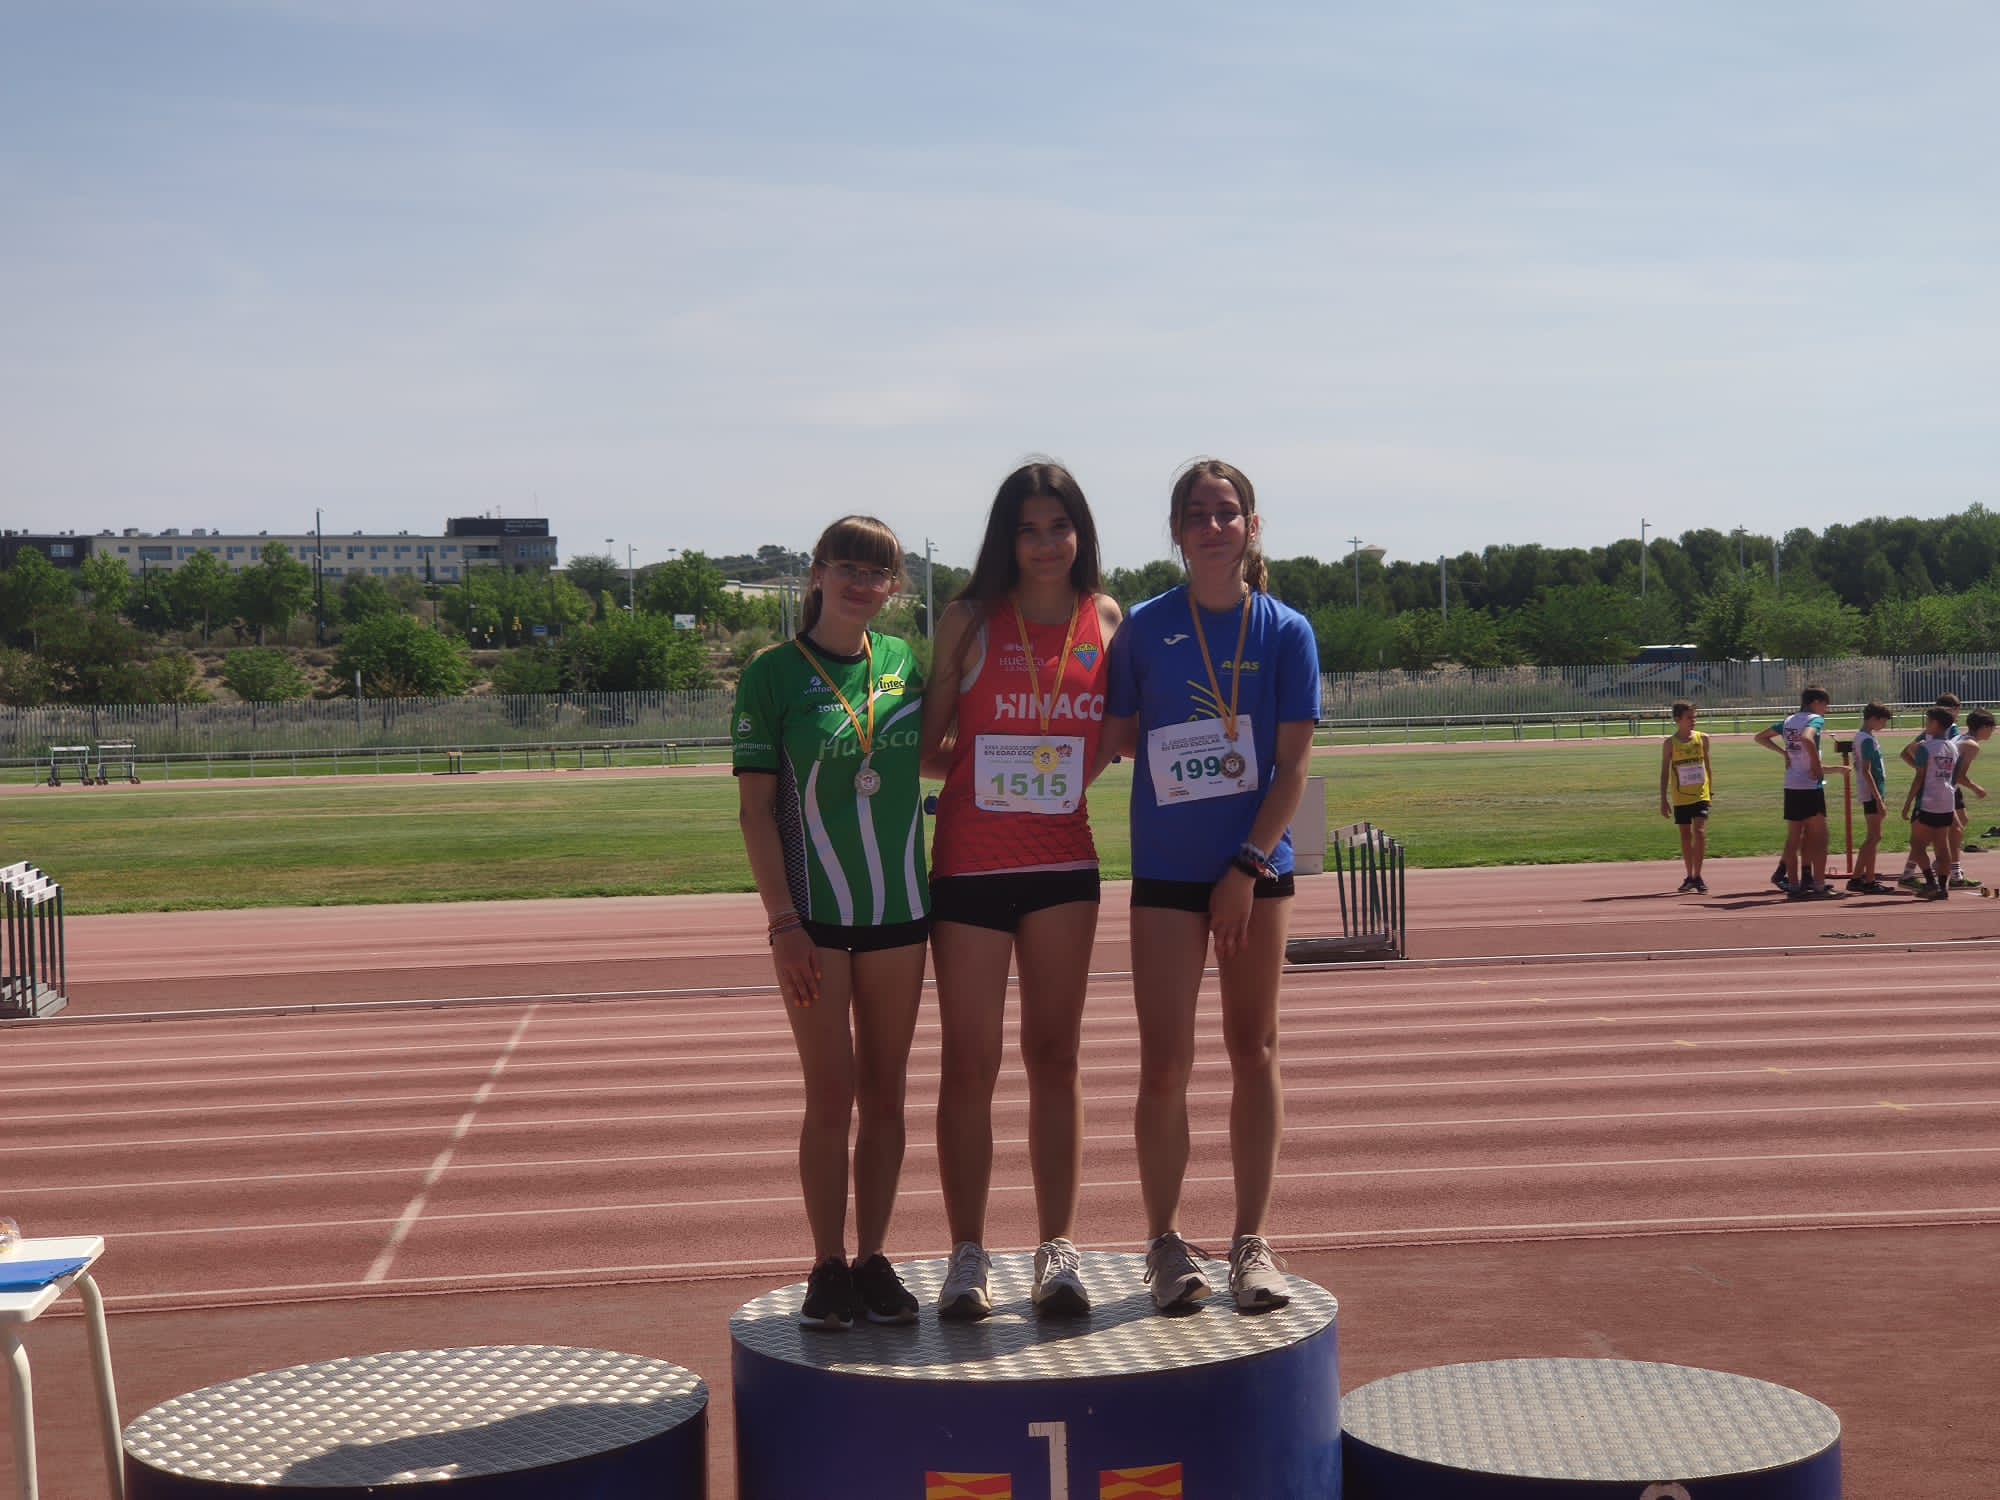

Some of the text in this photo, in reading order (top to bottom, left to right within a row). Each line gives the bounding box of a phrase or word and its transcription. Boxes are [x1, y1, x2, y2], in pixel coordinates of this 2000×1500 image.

[1222, 661, 1259, 671] AAS
[879, 677, 904, 689] intec
[818, 730, 919, 761] Husca
[1170, 756, 1222, 781] 199
[991, 773, 1067, 796] 1515
[1028, 1421, 1068, 1500] 1
